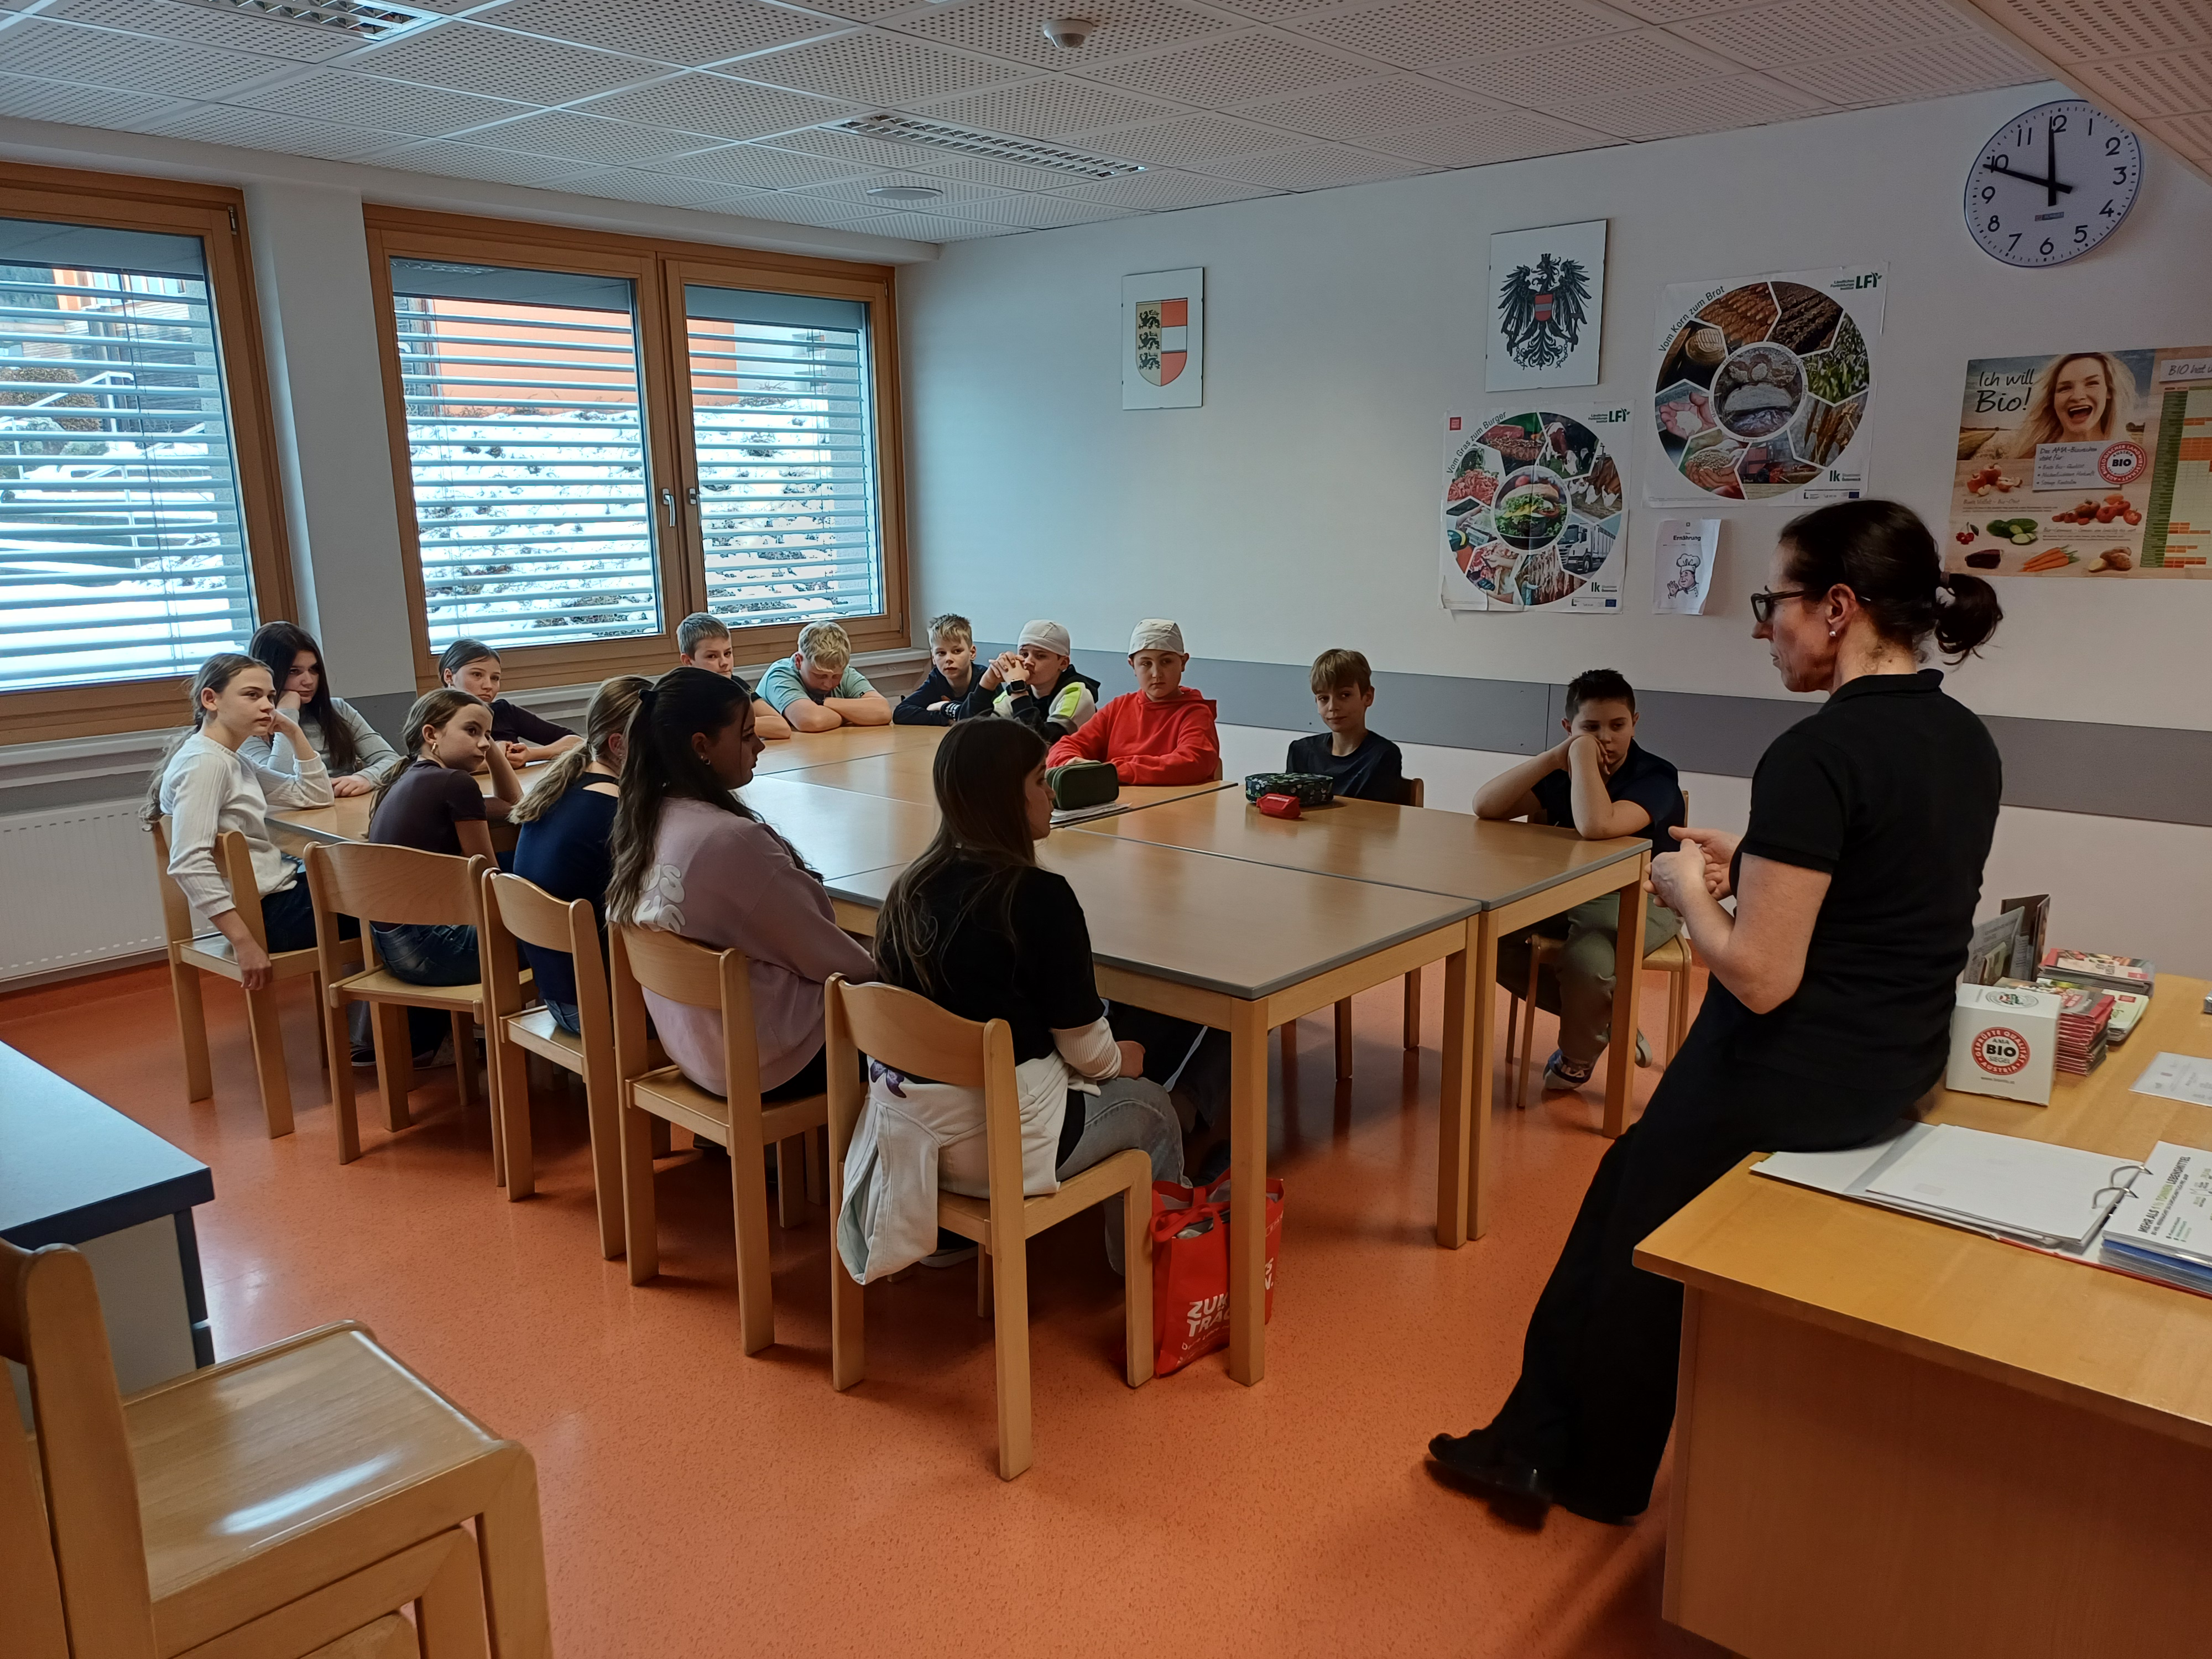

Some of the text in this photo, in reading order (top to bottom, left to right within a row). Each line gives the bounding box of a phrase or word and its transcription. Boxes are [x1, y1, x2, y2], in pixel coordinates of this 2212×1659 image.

[2088, 118, 2093, 136] 1
[2017, 127, 2032, 147] 11
[2105, 137, 2121, 156] 2
[1990, 154, 2009, 173] 10
[2112, 166, 2127, 185] 3
[1981, 186, 1996, 204] 9
[2099, 199, 2114, 217] 4
[1987, 215, 2000, 232] 8
[2008, 233, 2022, 252] 7
[2073, 225, 2088, 243] 5
[2039, 237, 2054, 255] 6
[1658, 285, 1725, 352] Vom Korn zum Brot
[1980, 368, 2035, 387] Ich will
[2168, 364, 2189, 376] BIO
[1975, 387, 2032, 413] Bio!
[1446, 411, 1506, 474] Vom Gras zum Burger
[2101, 445, 2126, 474] BIOLOGISCHER
[2112, 458, 2132, 467] BIO
[1986, 1044, 2016, 1057] BIO
[1561, 1064, 1585, 1078] ILA
[1980, 1062, 2018, 1073] AUSTRIA
[2137, 1218, 2154, 1233] MEHR
[2146, 1209, 2160, 1220] ALS
[2165, 1156, 2191, 1185] LEBENSMITTEL
[1187, 1292, 1229, 1318] ZUK
